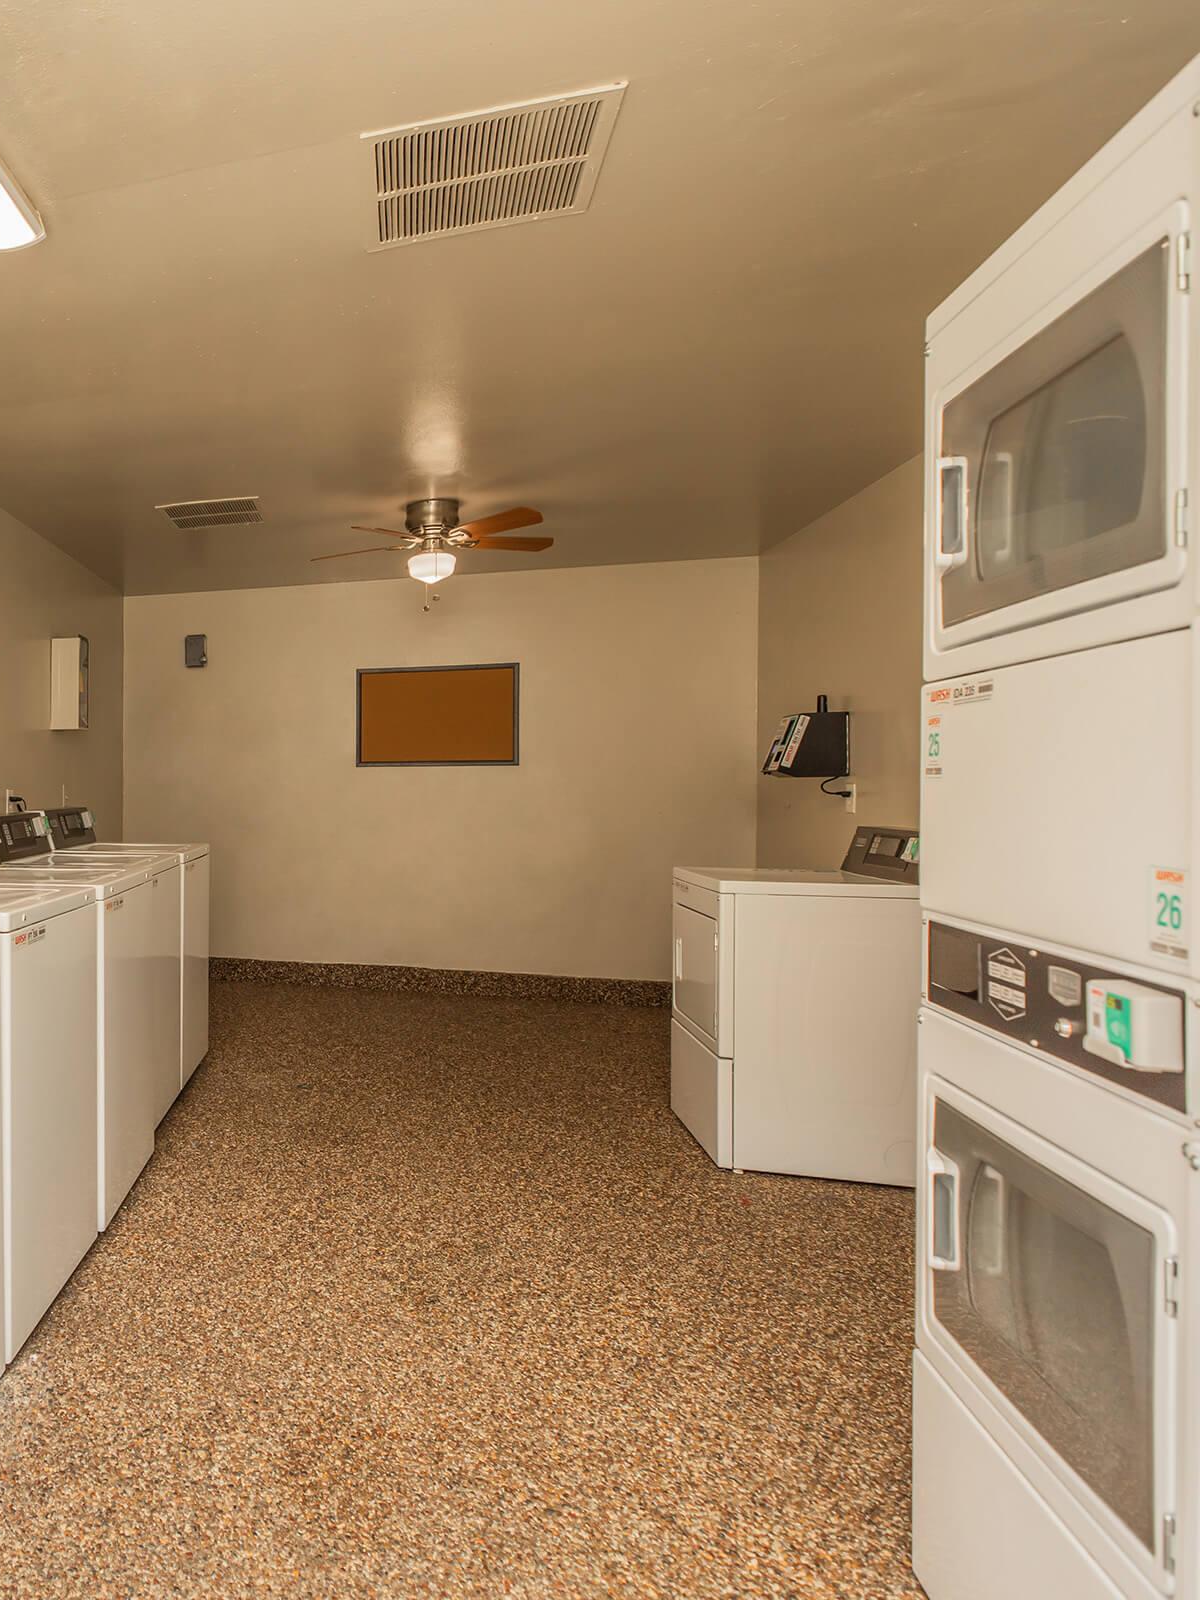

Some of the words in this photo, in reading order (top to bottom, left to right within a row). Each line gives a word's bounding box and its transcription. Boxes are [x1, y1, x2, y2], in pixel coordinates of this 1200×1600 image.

[930, 689, 951, 703] WASH
[928, 733, 940, 757] 25
[1155, 870, 1184, 884] WASH
[1156, 892, 1182, 929] 26
